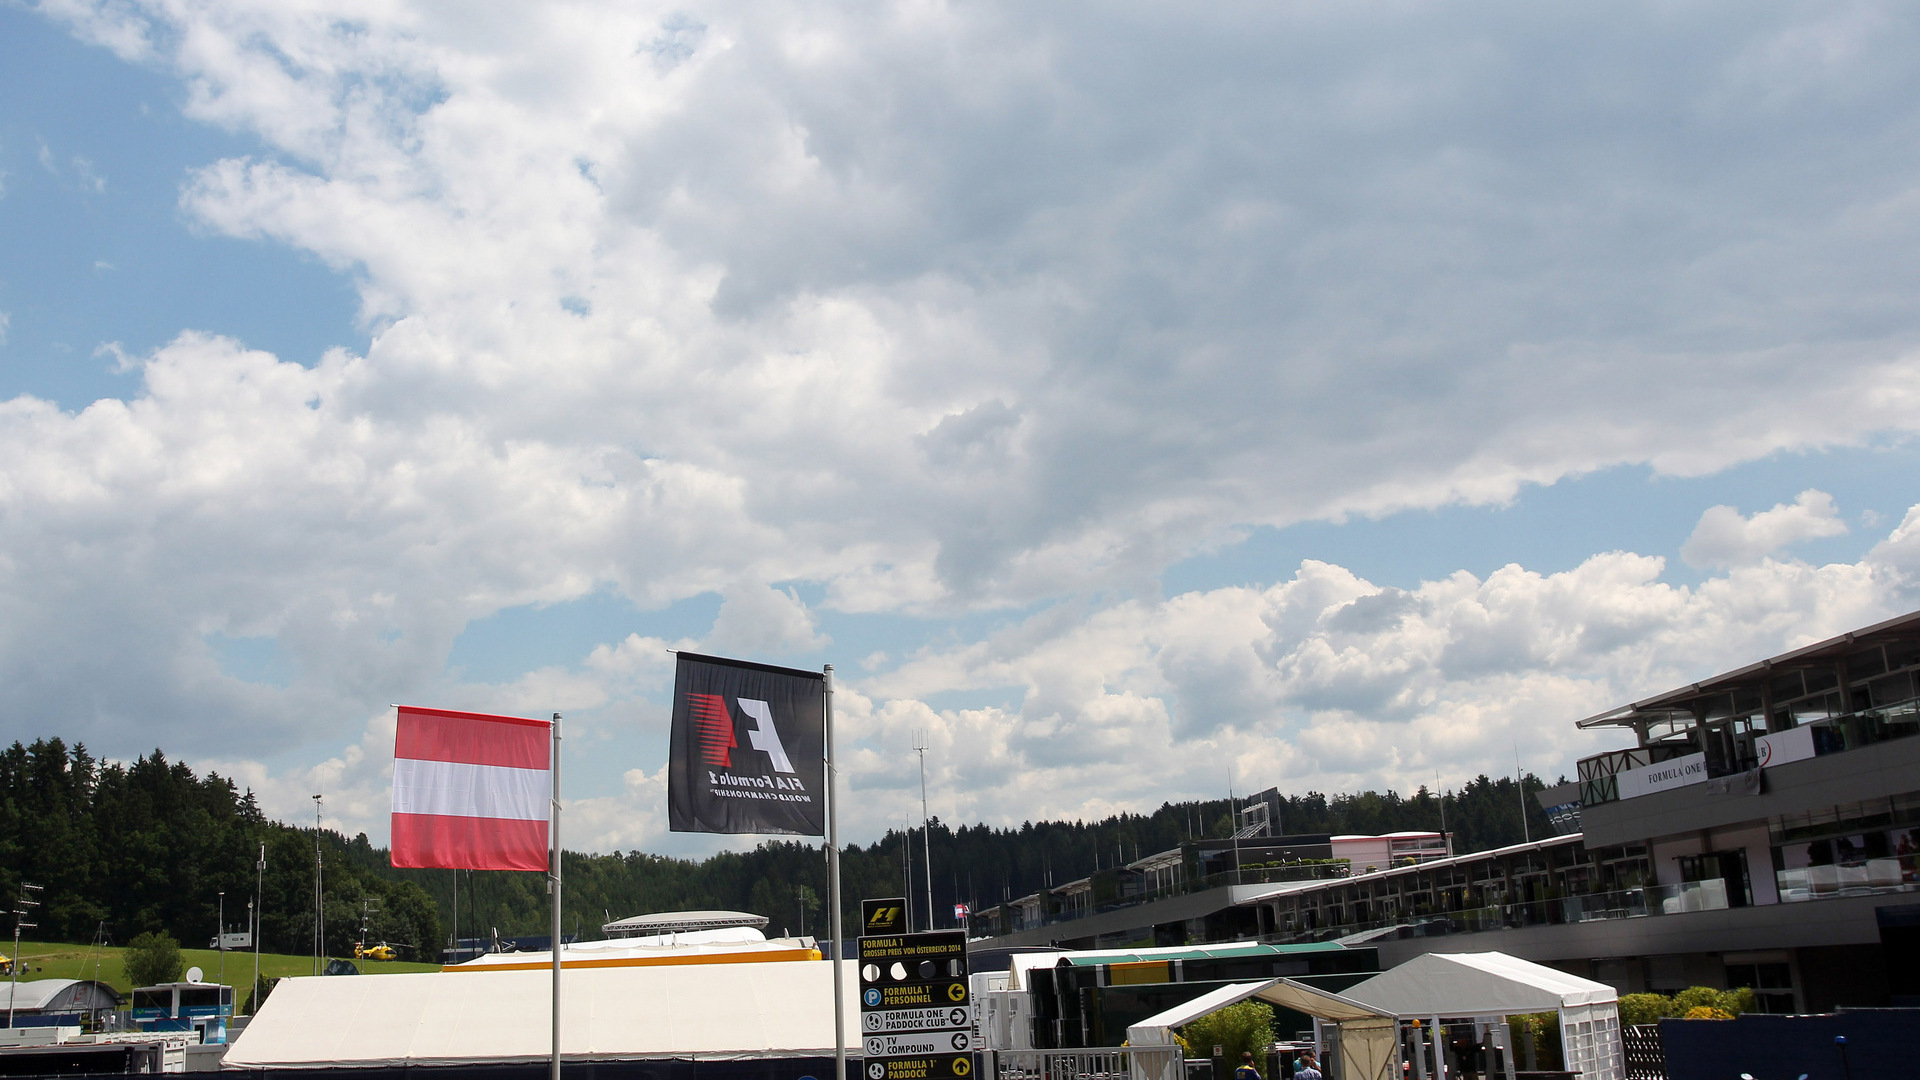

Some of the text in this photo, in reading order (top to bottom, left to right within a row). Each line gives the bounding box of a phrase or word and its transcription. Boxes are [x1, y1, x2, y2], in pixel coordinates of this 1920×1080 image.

[1648, 767, 1684, 784] FORMULA
[1685, 761, 1701, 776] ONE
[870, 907, 901, 923] F1
[863, 938, 903, 949] FORMULA 1
[863, 944, 961, 958] GROSSER PREIS VON ÖSTERREICH 2014
[883, 986, 923, 996] FORMULA
[868, 991, 878, 1004] P
[884, 994, 932, 1005] PERSONNEL
[885, 1009, 944, 1021] FORMULA ONE
[886, 1020, 924, 1030] PADDOCK
[887, 1037, 897, 1046] TV
[887, 1044, 935, 1055] COMPOUND
[887, 1060, 928, 1070] FORMULA
[888, 1069, 927, 1080] PADDOCK
